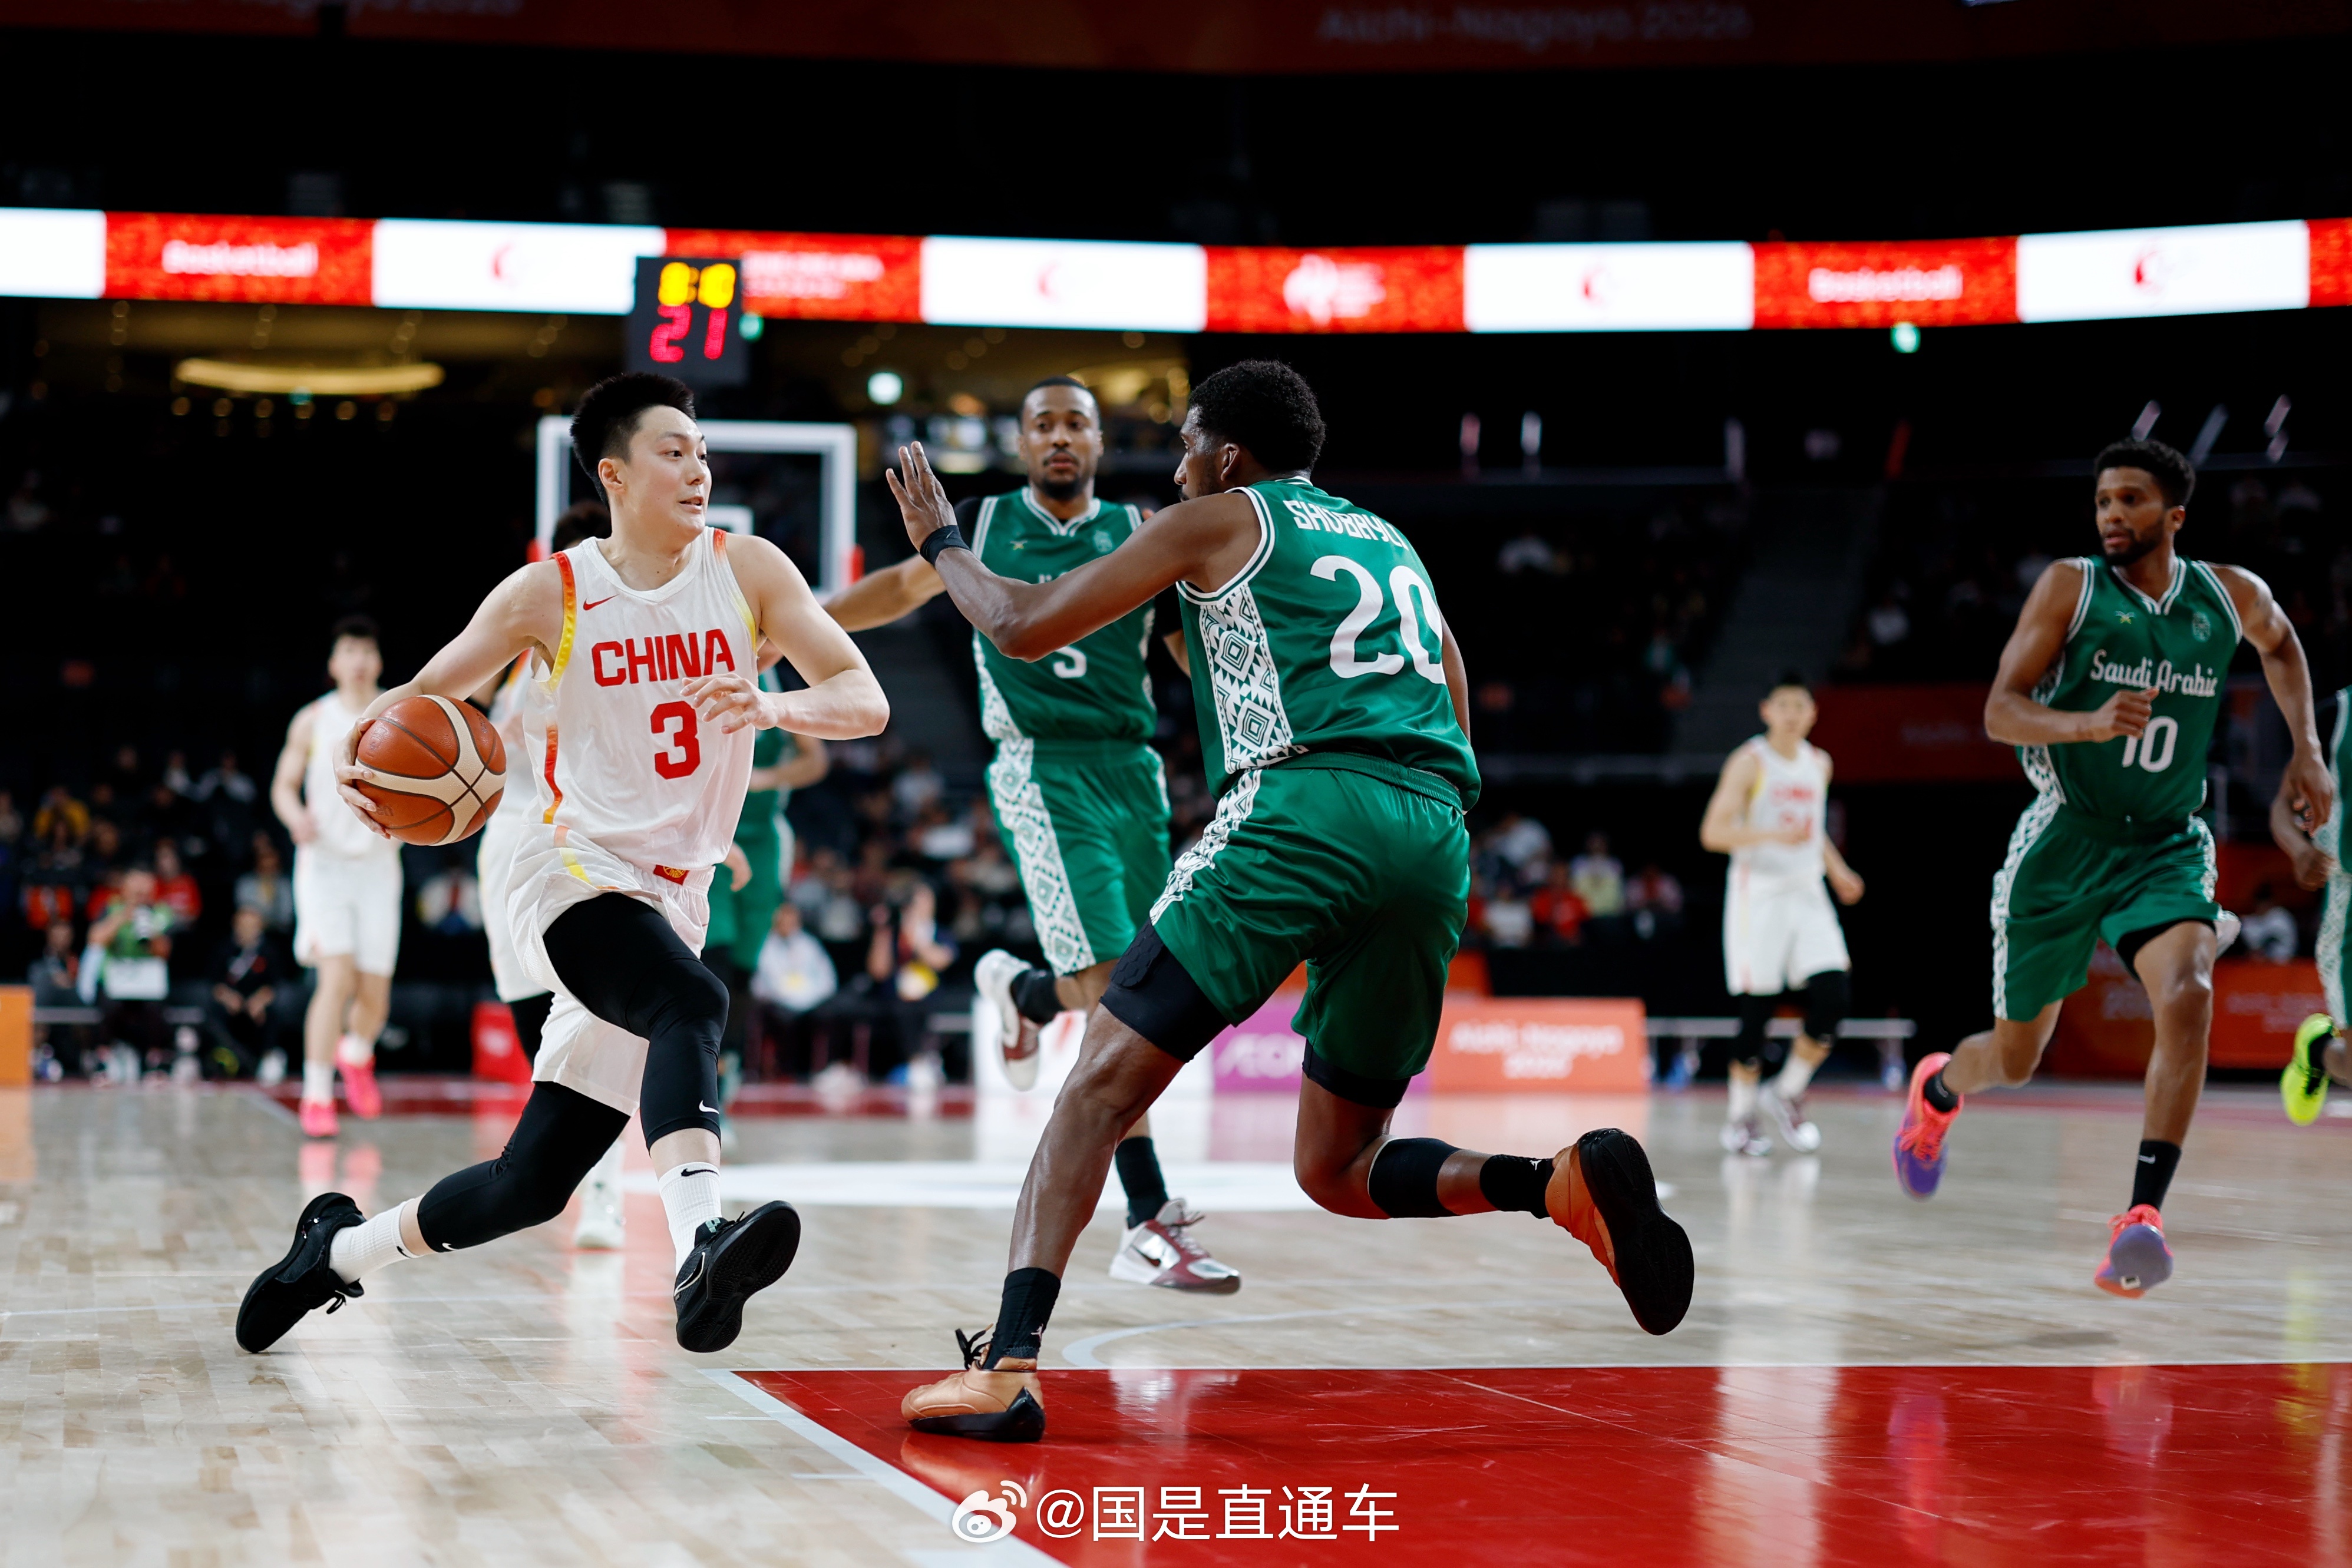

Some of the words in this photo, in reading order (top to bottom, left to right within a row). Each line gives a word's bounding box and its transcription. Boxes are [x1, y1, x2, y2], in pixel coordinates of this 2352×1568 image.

[649, 303, 729, 363] 21
[1310, 555, 1446, 685] 20
[592, 628, 735, 687] CHINA
[2090, 649, 2153, 689] Saudi
[650, 700, 701, 780] 3
[2122, 715, 2178, 773] 10
